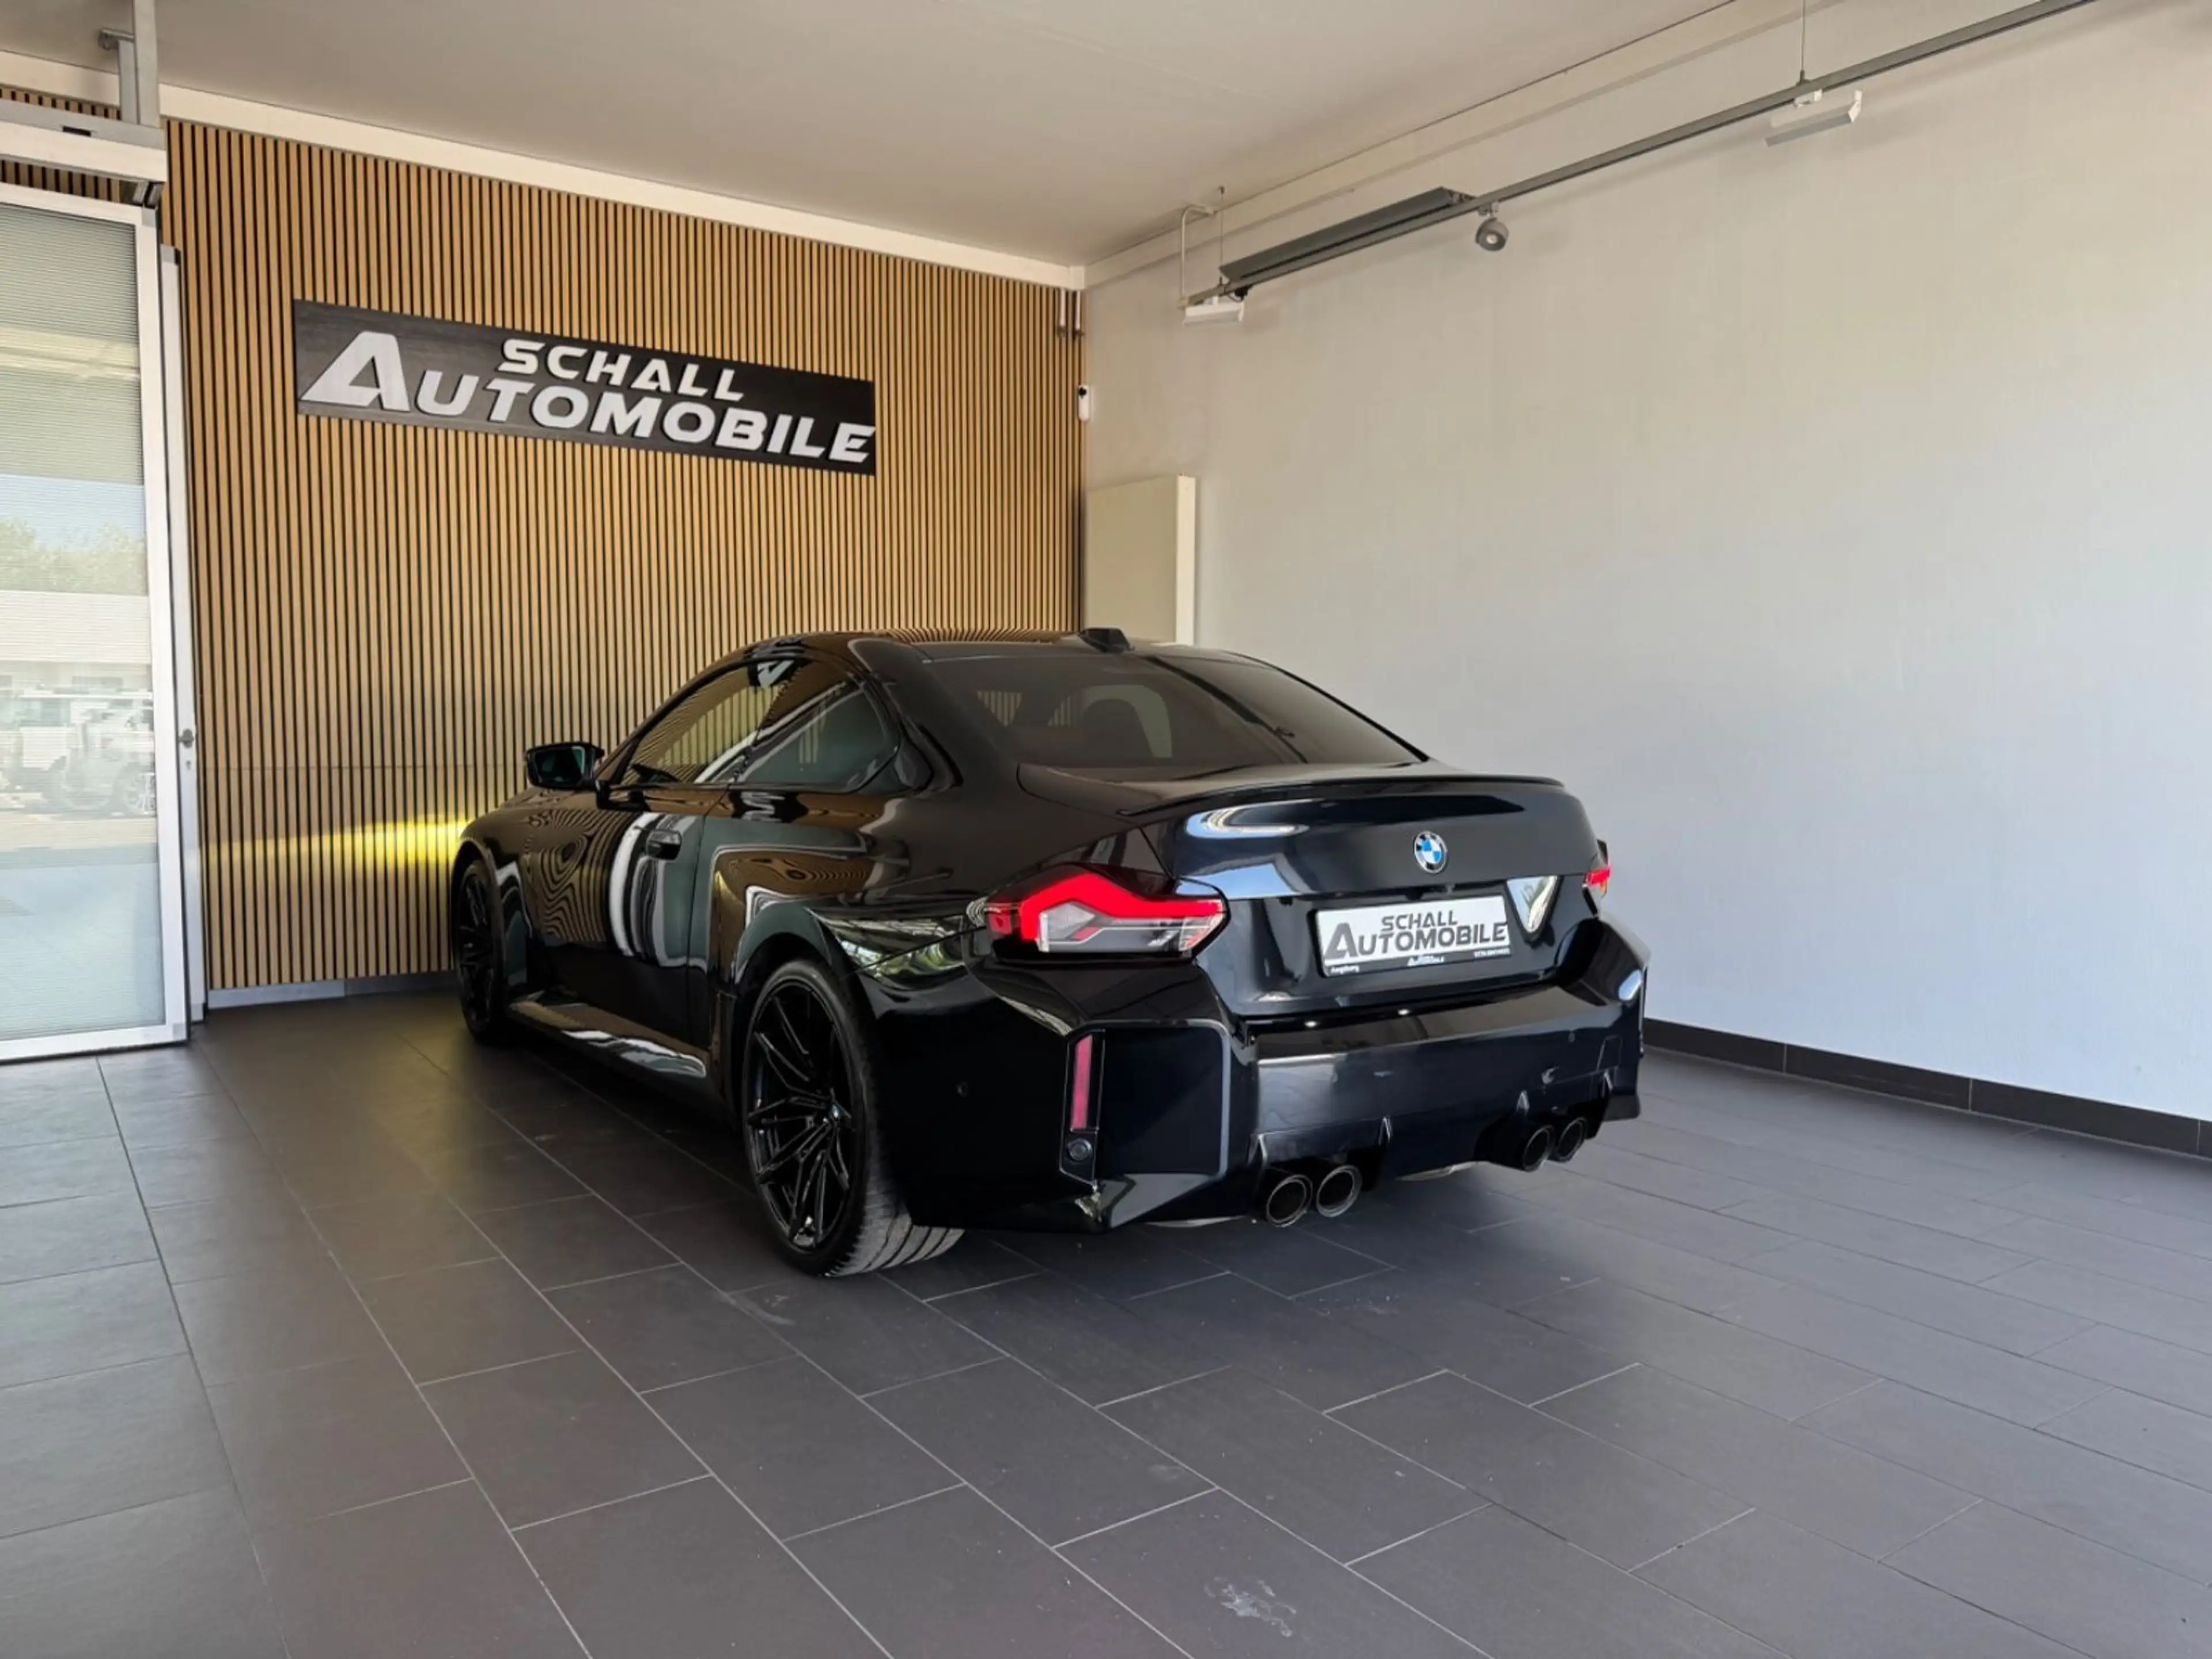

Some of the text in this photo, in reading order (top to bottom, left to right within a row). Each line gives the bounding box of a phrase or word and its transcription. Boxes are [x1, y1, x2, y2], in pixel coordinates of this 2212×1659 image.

[498, 338, 744, 402] SCHALL
[300, 330, 876, 463] AUTOMOBILE
[1324, 922, 1508, 960] AUTOMOBILE
[1381, 910, 1458, 932] SCHALL
